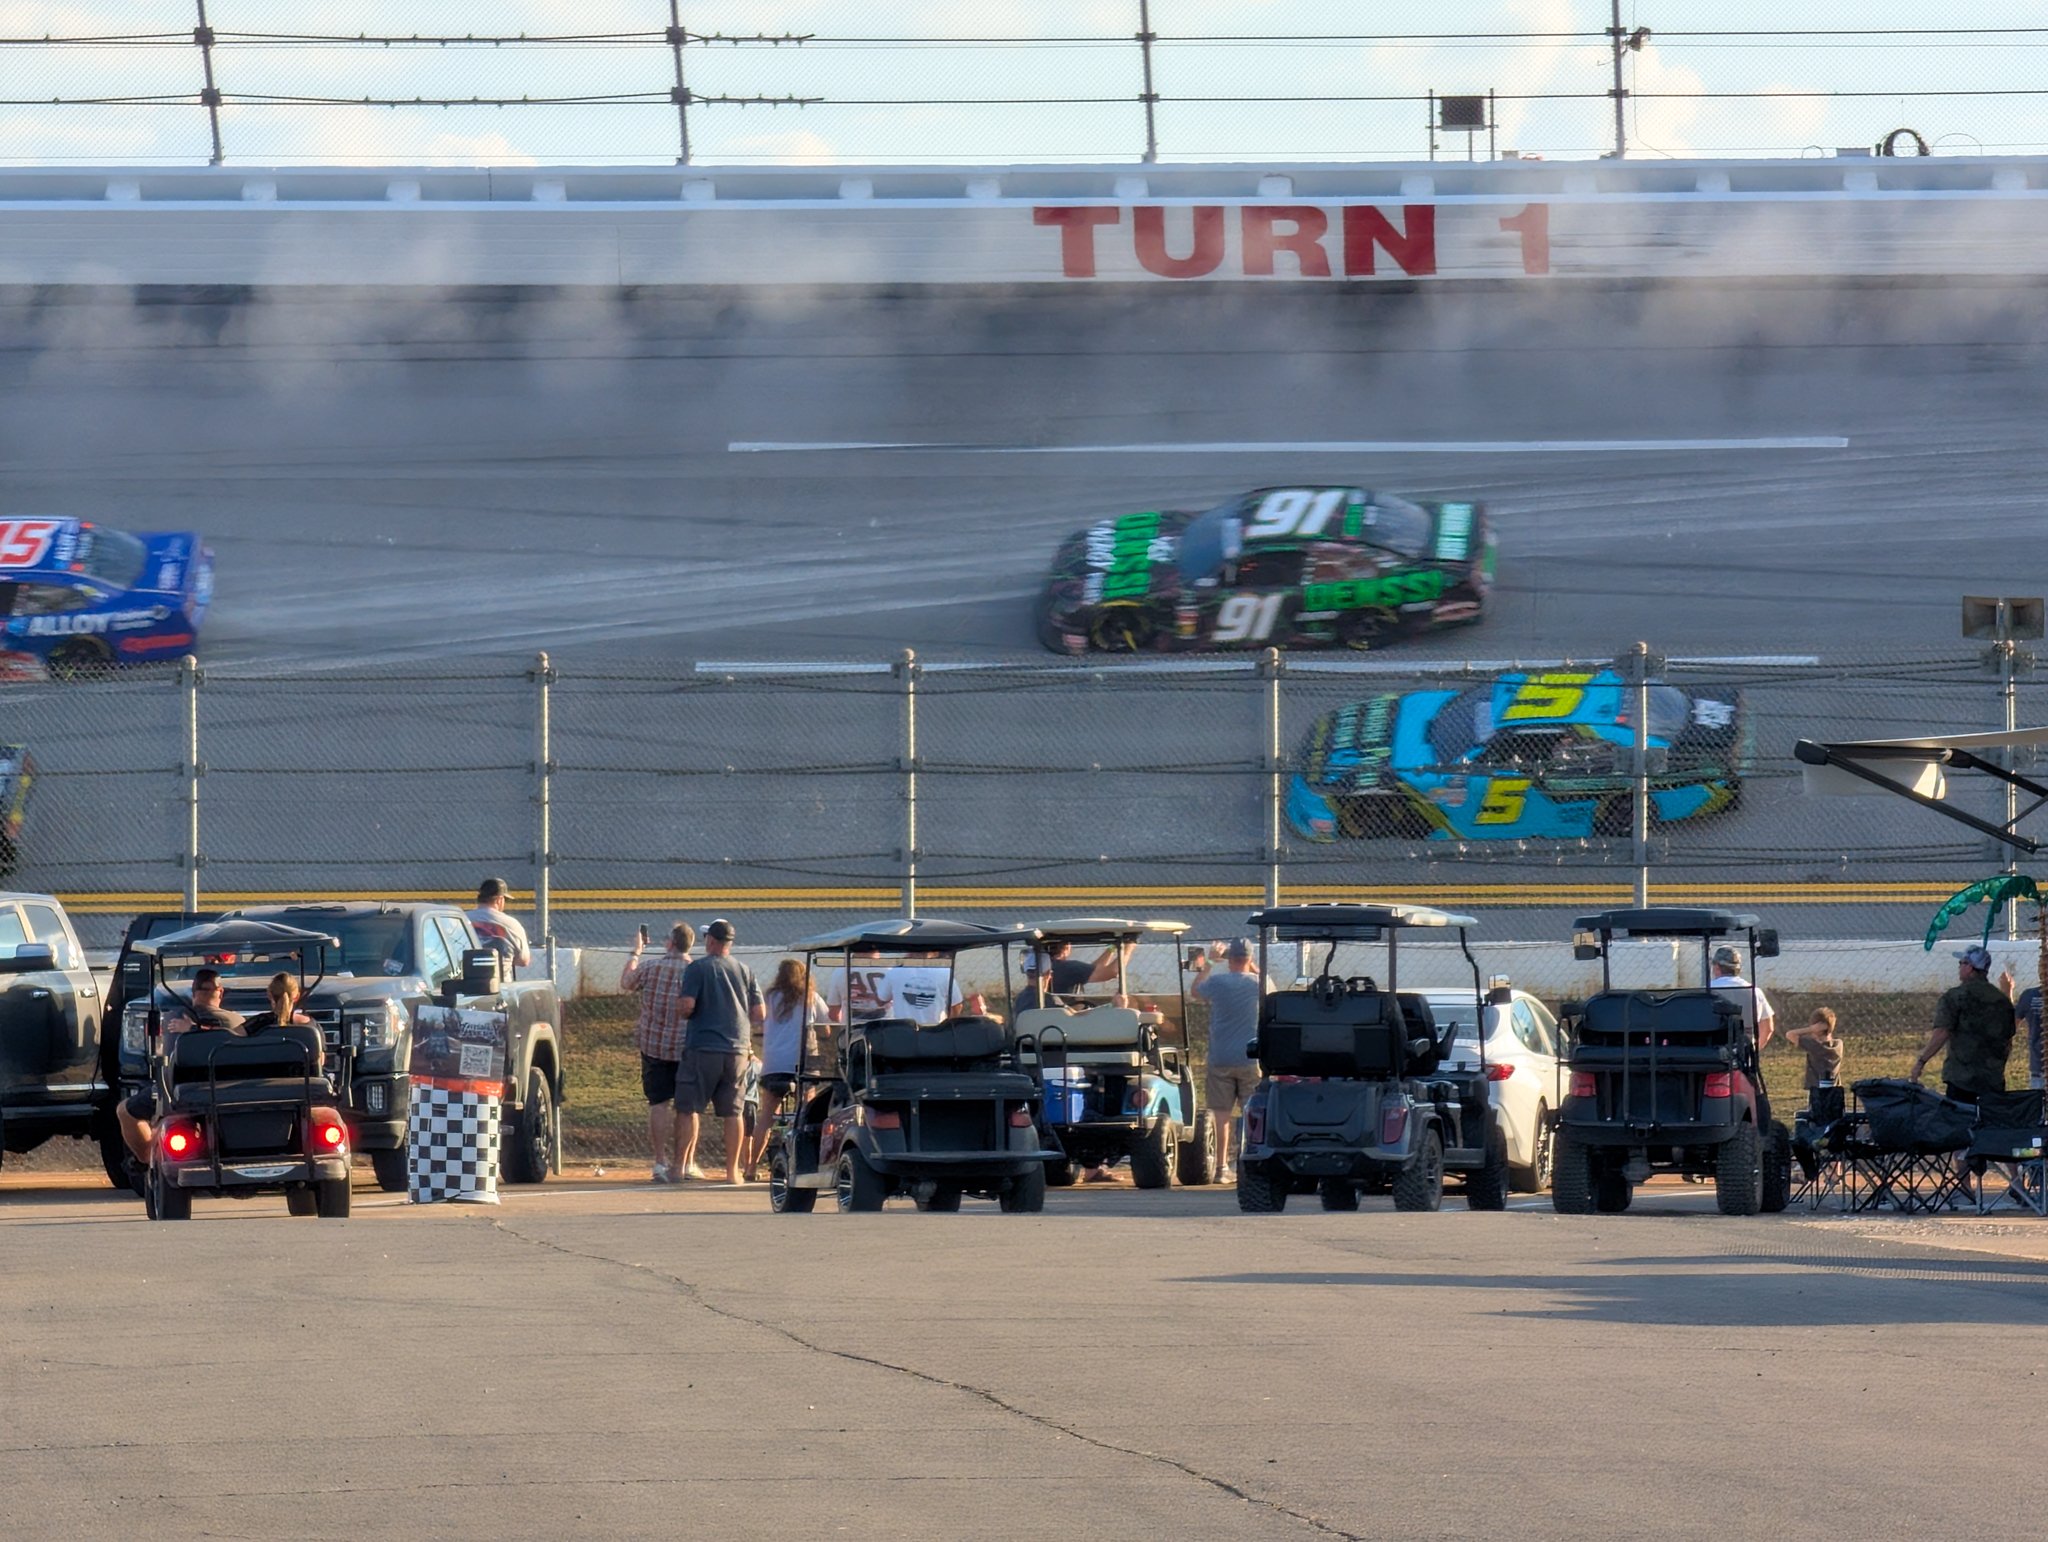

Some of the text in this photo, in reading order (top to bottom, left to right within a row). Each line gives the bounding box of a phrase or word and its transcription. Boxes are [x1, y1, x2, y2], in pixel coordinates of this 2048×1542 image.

[1033, 203, 1550, 279] TURN 1
[1245, 490, 1346, 536] 91
[0, 522, 54, 565] 5
[1212, 592, 1286, 641] 91
[1503, 673, 1597, 720] 5
[1474, 779, 1532, 824] 5
